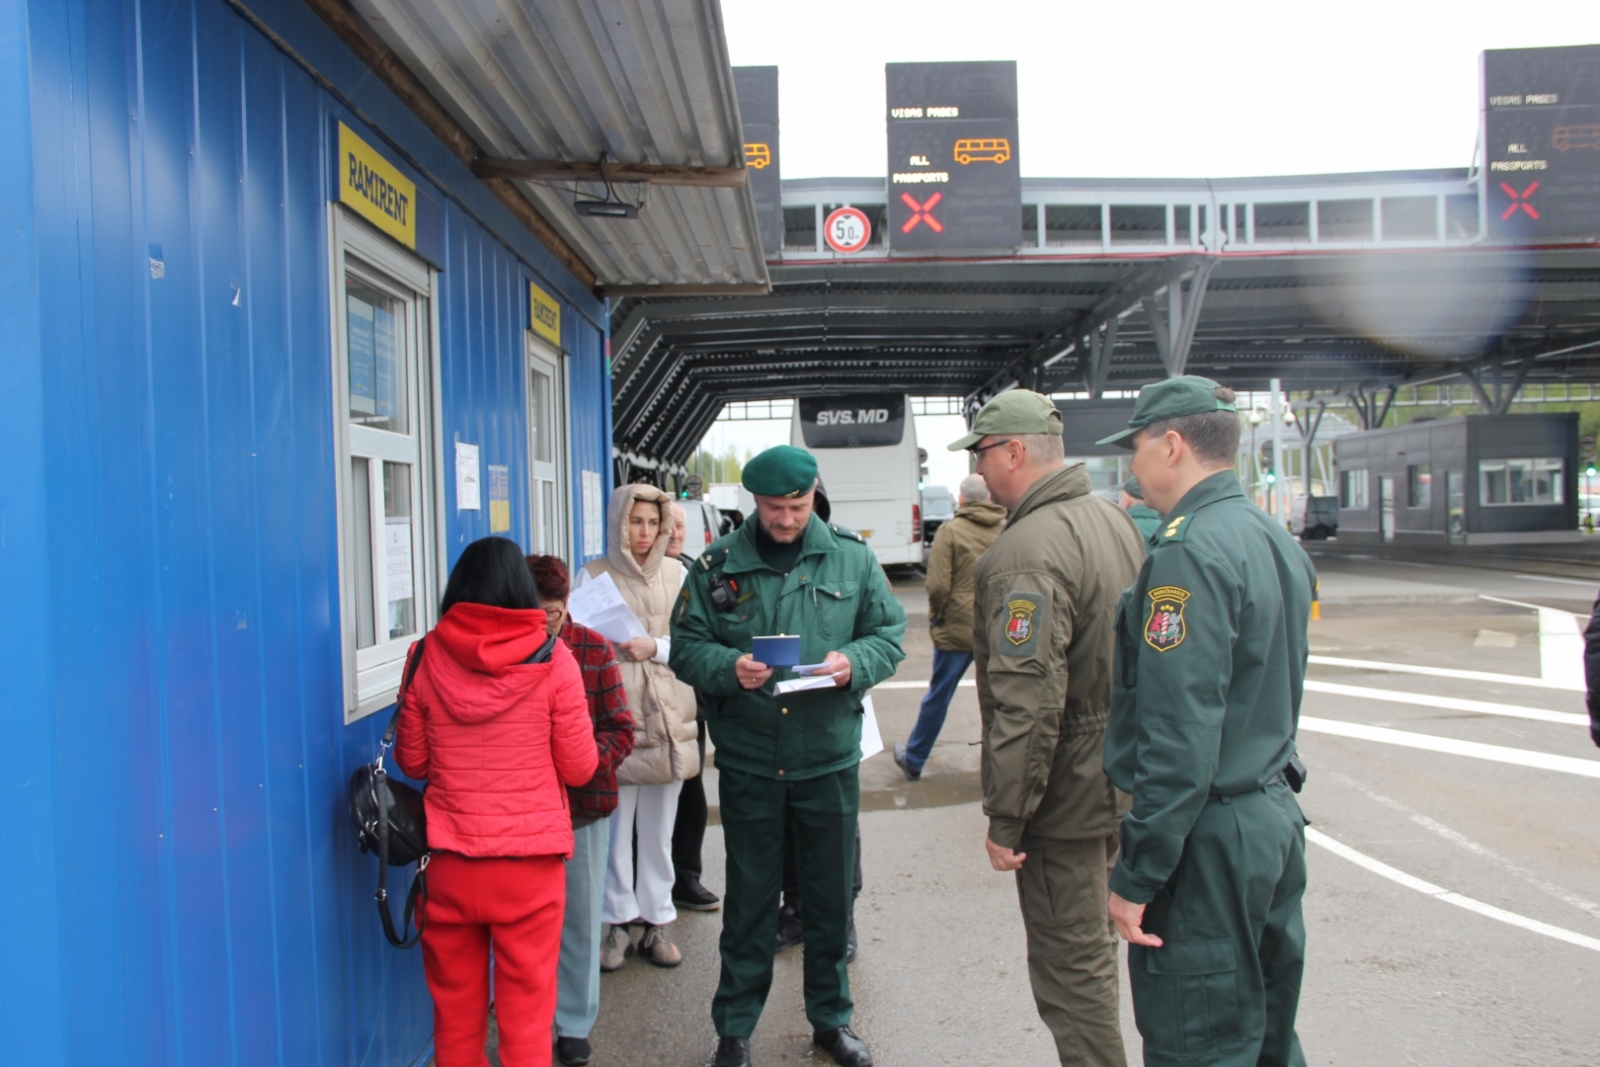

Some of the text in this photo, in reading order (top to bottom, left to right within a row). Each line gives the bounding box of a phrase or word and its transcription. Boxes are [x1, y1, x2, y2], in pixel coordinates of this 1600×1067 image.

[891, 107, 923, 118] VISAS
[1507, 143, 1528, 154] ALL
[910, 155, 930, 166] ALL
[1490, 159, 1548, 171] PASSPORTS
[892, 171, 949, 183] PASSPORTS
[348, 150, 408, 227] RAMIRENT
